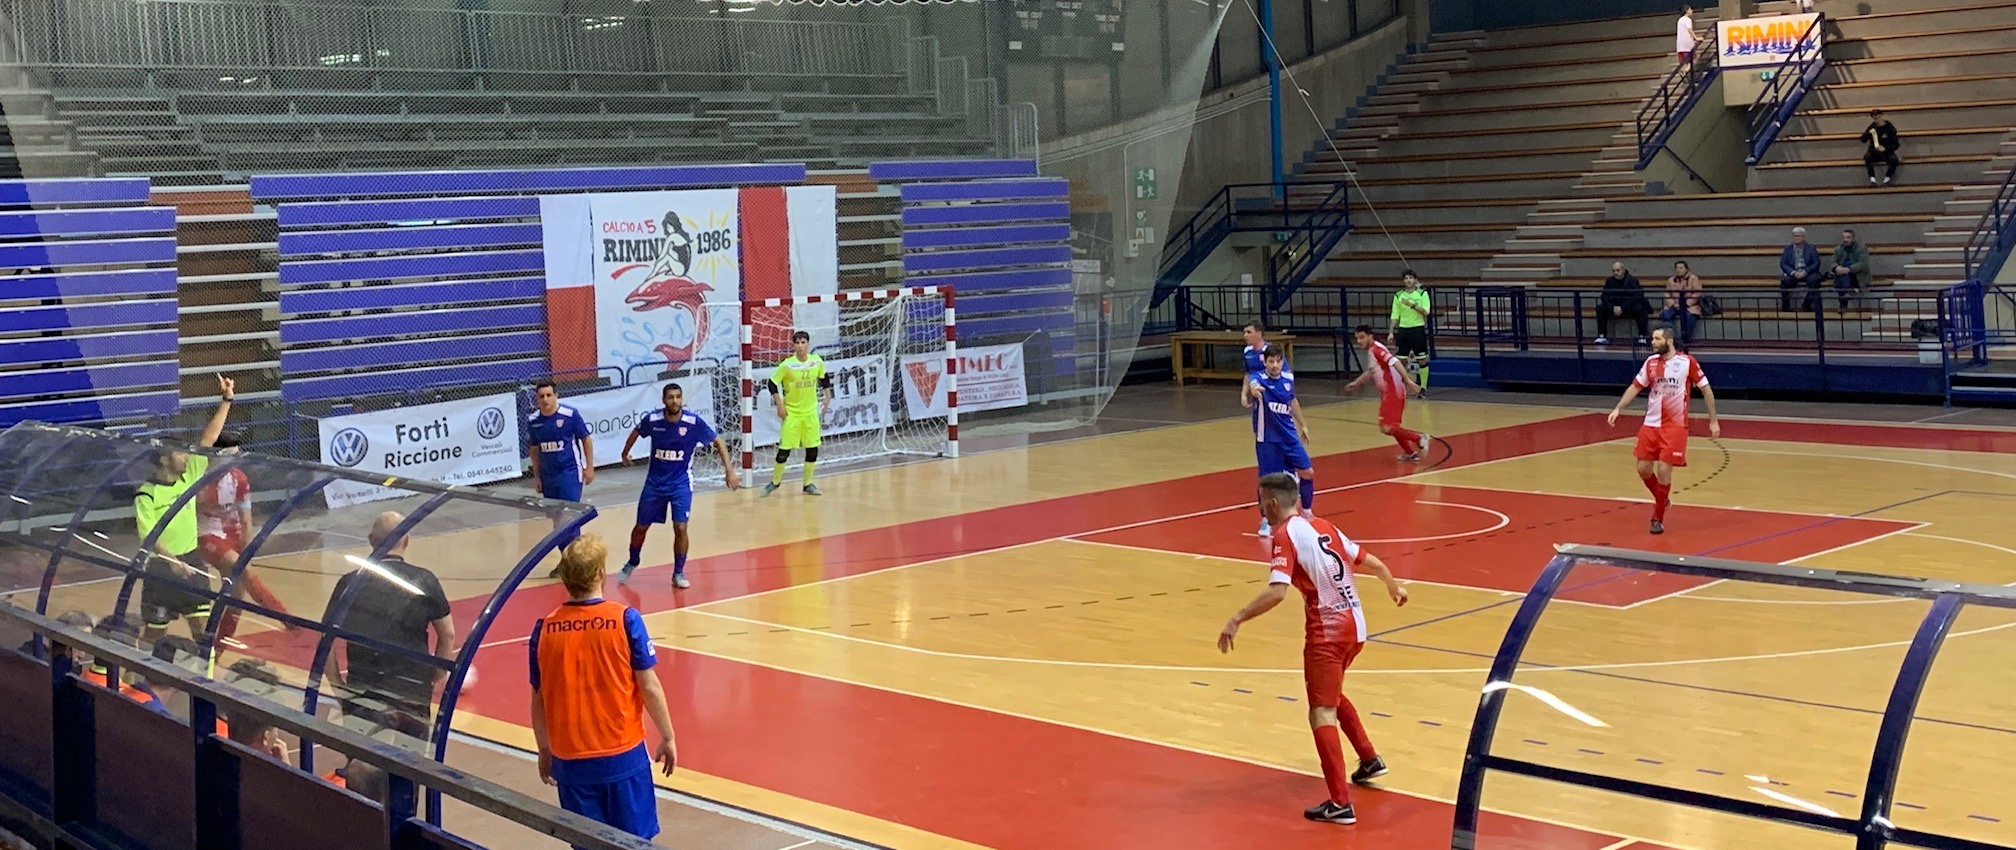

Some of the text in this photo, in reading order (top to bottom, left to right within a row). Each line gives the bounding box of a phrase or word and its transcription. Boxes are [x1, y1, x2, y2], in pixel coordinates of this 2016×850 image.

[1726, 20, 1813, 53] RIMINI
[603, 219, 656, 234] CALCIO A 5
[696, 228, 731, 255] 1986
[945, 352, 1008, 374] IMEC
[801, 370, 810, 380] 22
[395, 417, 449, 444] Forti
[385, 445, 463, 468] Riccione
[480, 442, 503, 451] Veicoli
[1317, 535, 1345, 582] 5
[546, 616, 617, 634] macron
